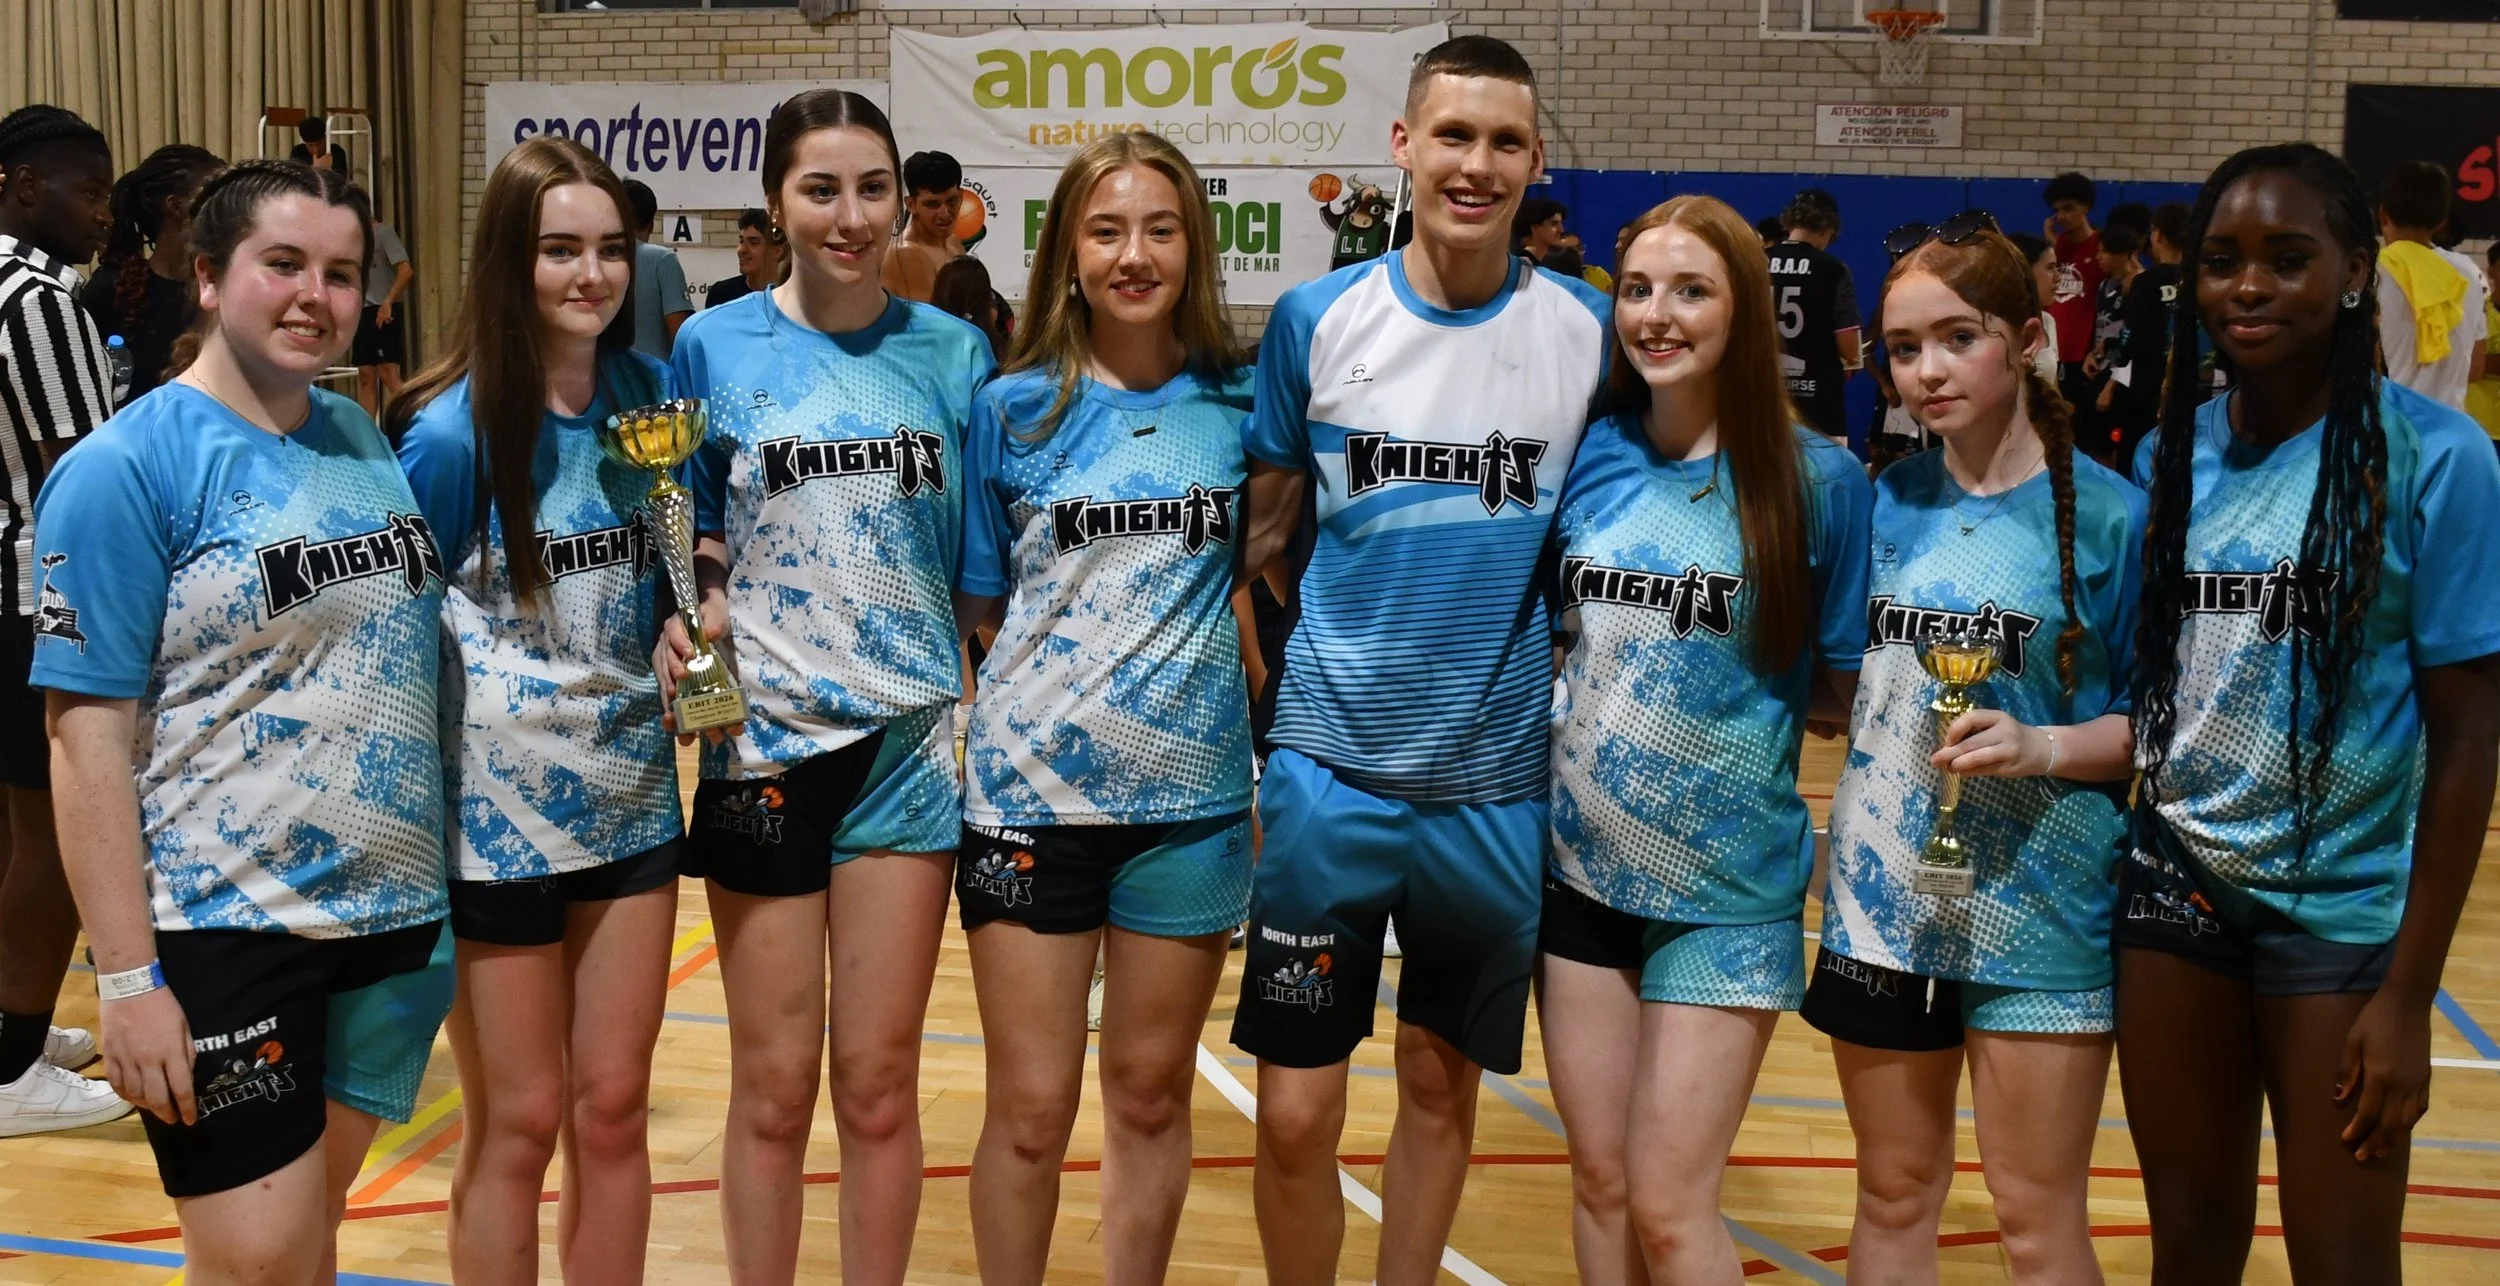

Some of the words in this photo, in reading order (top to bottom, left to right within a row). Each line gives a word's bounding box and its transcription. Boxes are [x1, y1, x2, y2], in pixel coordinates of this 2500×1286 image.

[1897, 107, 1949, 118] PELIGRO
[1152, 113, 1346, 152] technology
[1897, 127, 1937, 137] PERILL
[673, 215, 692, 241] A
[1234, 257, 1248, 271] DE
[1254, 257, 1280, 272] MAR
[1002, 829, 1035, 846] EAST
[1261, 925, 1297, 947] NORTH
[1301, 933, 1335, 948] EAST
[233, 1016, 278, 1044] EAST
